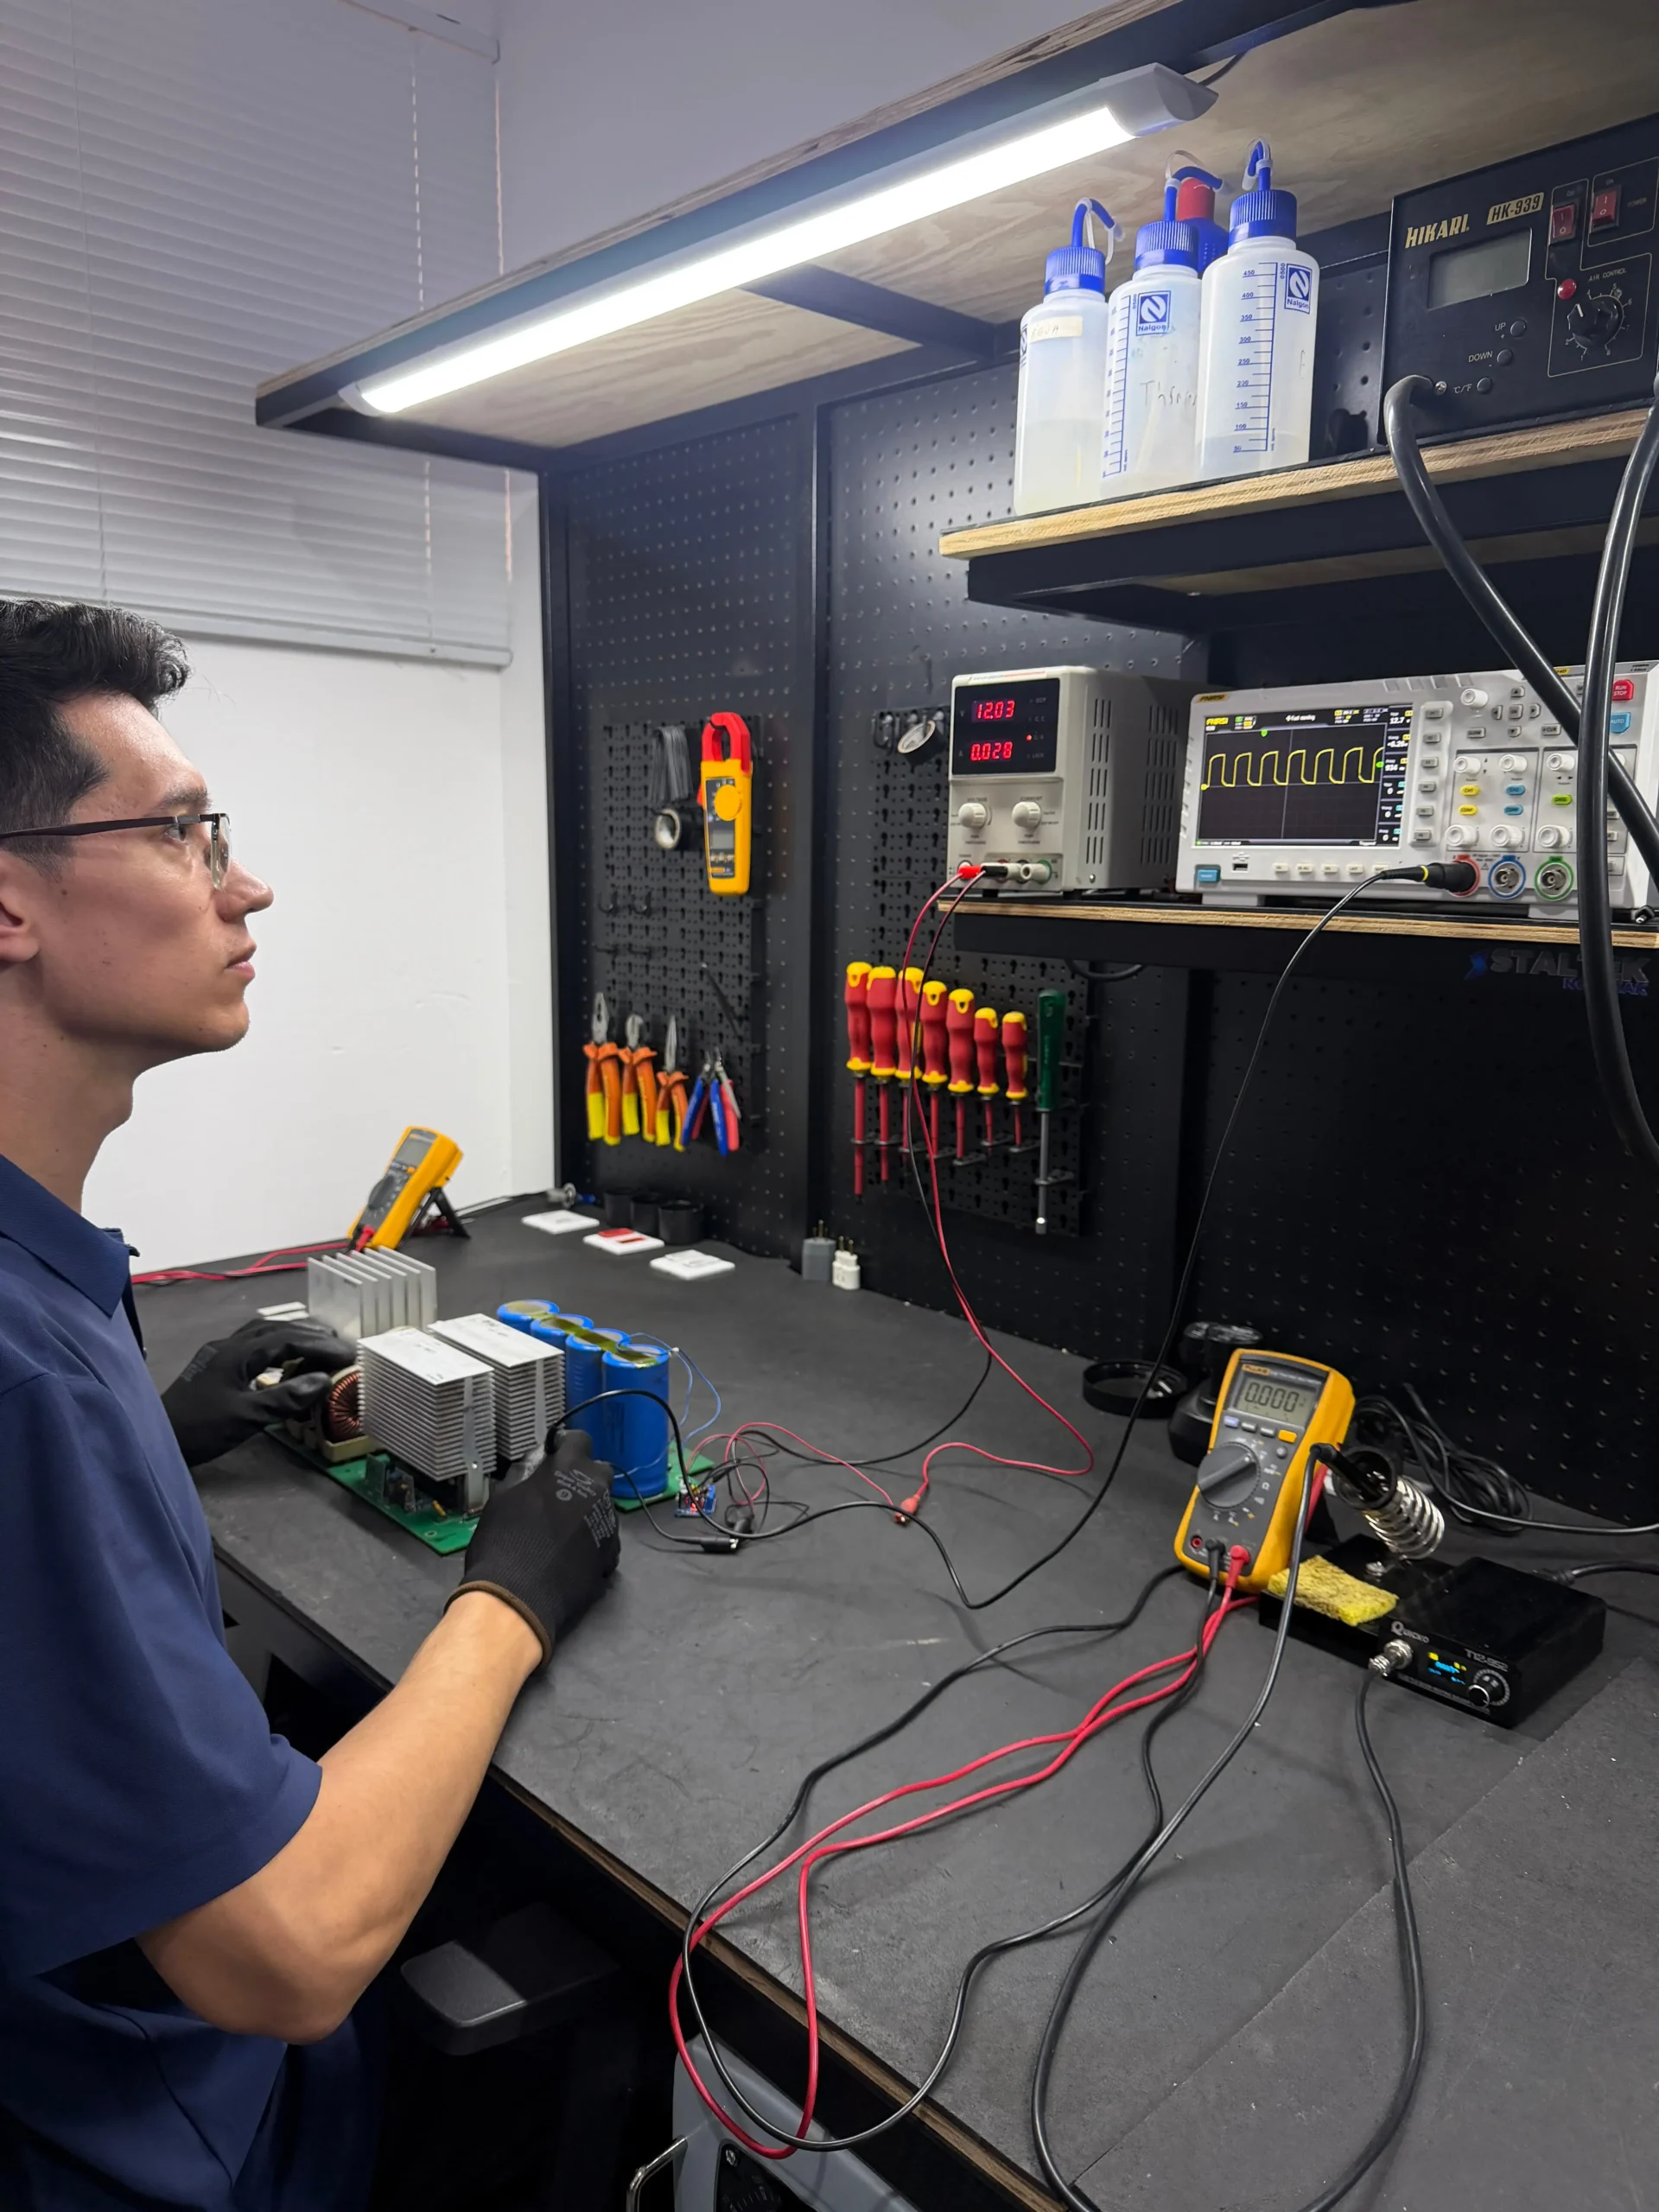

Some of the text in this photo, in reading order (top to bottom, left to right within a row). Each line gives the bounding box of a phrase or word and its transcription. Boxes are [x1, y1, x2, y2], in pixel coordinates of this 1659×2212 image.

[1491, 194, 1541, 222] HK-939
[1602, 268, 1627, 278] CONTROL
[1495, 322, 1506, 331] UP
[1468, 351, 1493, 363] DOWN
[976, 700, 1015, 719] 12.03
[970, 741, 1014, 761] 0.028
[1244, 1382, 1300, 1413] 0.000
